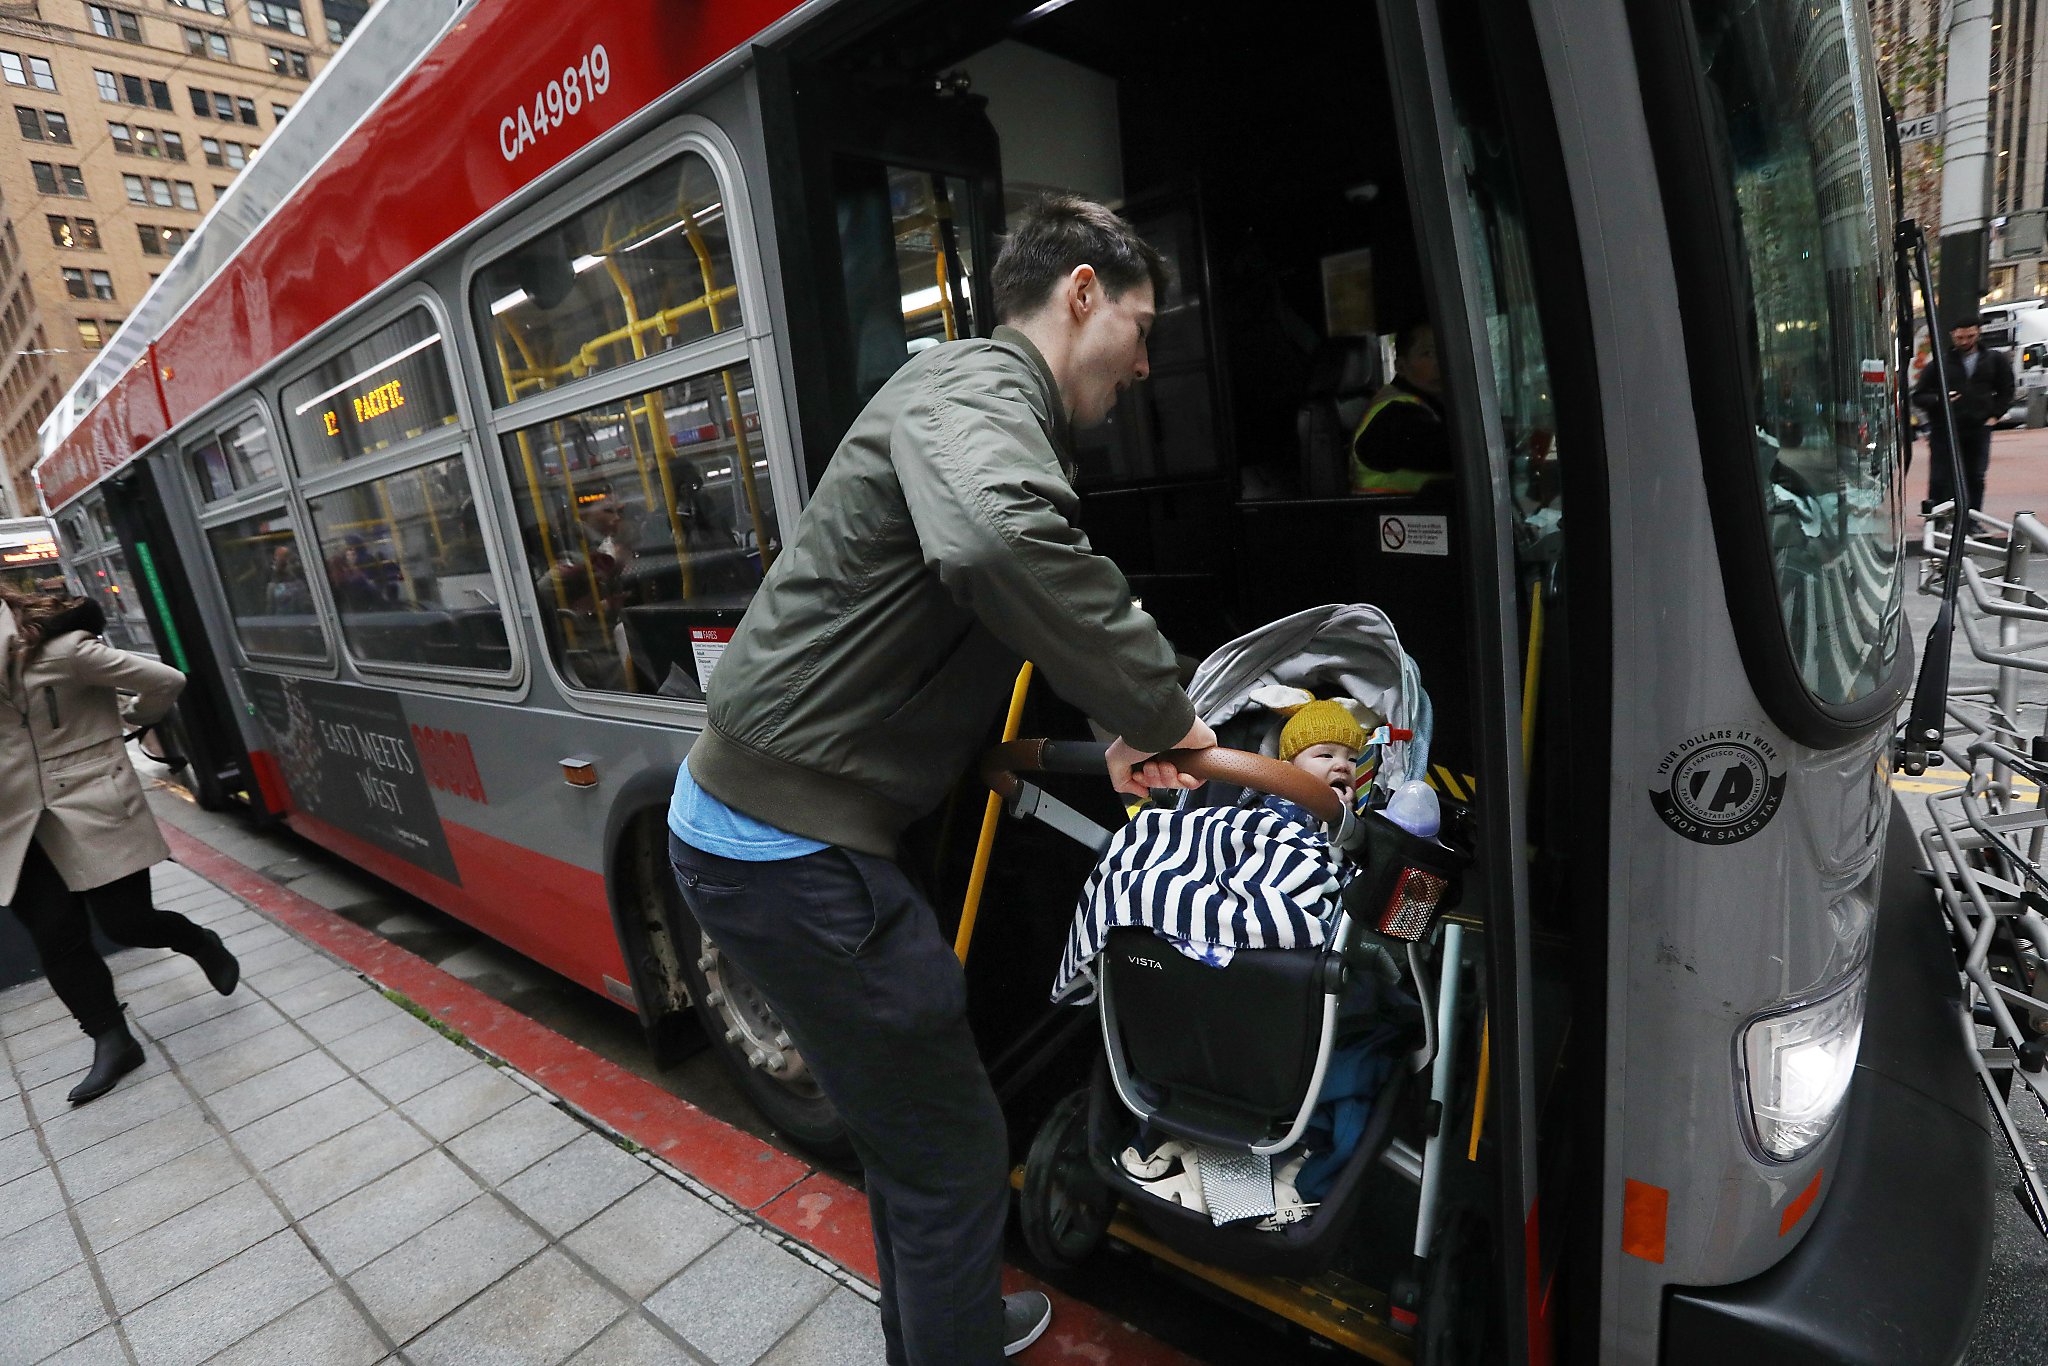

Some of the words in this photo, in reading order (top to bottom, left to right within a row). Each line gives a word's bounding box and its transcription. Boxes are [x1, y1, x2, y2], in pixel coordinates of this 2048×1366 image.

[499, 44, 610, 162] CA49819
[353, 379, 405, 423] PACIFIC
[702, 630, 718, 640] FARES
[318, 719, 358, 757] EAST
[351, 723, 414, 775] MEETS
[1657, 750, 1680, 775] YOUR
[1678, 730, 1732, 752] DOLLARS
[1736, 731, 1752, 741] AT
[1753, 736, 1778, 761] WORK
[1682, 766, 1694, 779] SAN
[1692, 750, 1734, 767] FRANCISCO
[1736, 752, 1759, 771] COUNTY
[356, 767, 403, 815] WEST
[1680, 788, 1737, 819] TRANSPORTATION
[1739, 778, 1761, 814] AUTHORITY
[1664, 808, 1697, 834] PROP
[1702, 830, 1711, 839] K
[1717, 819, 1759, 840] SALES
[1760, 795, 1778, 818] TAX
[1128, 955, 1163, 970] VISTA
